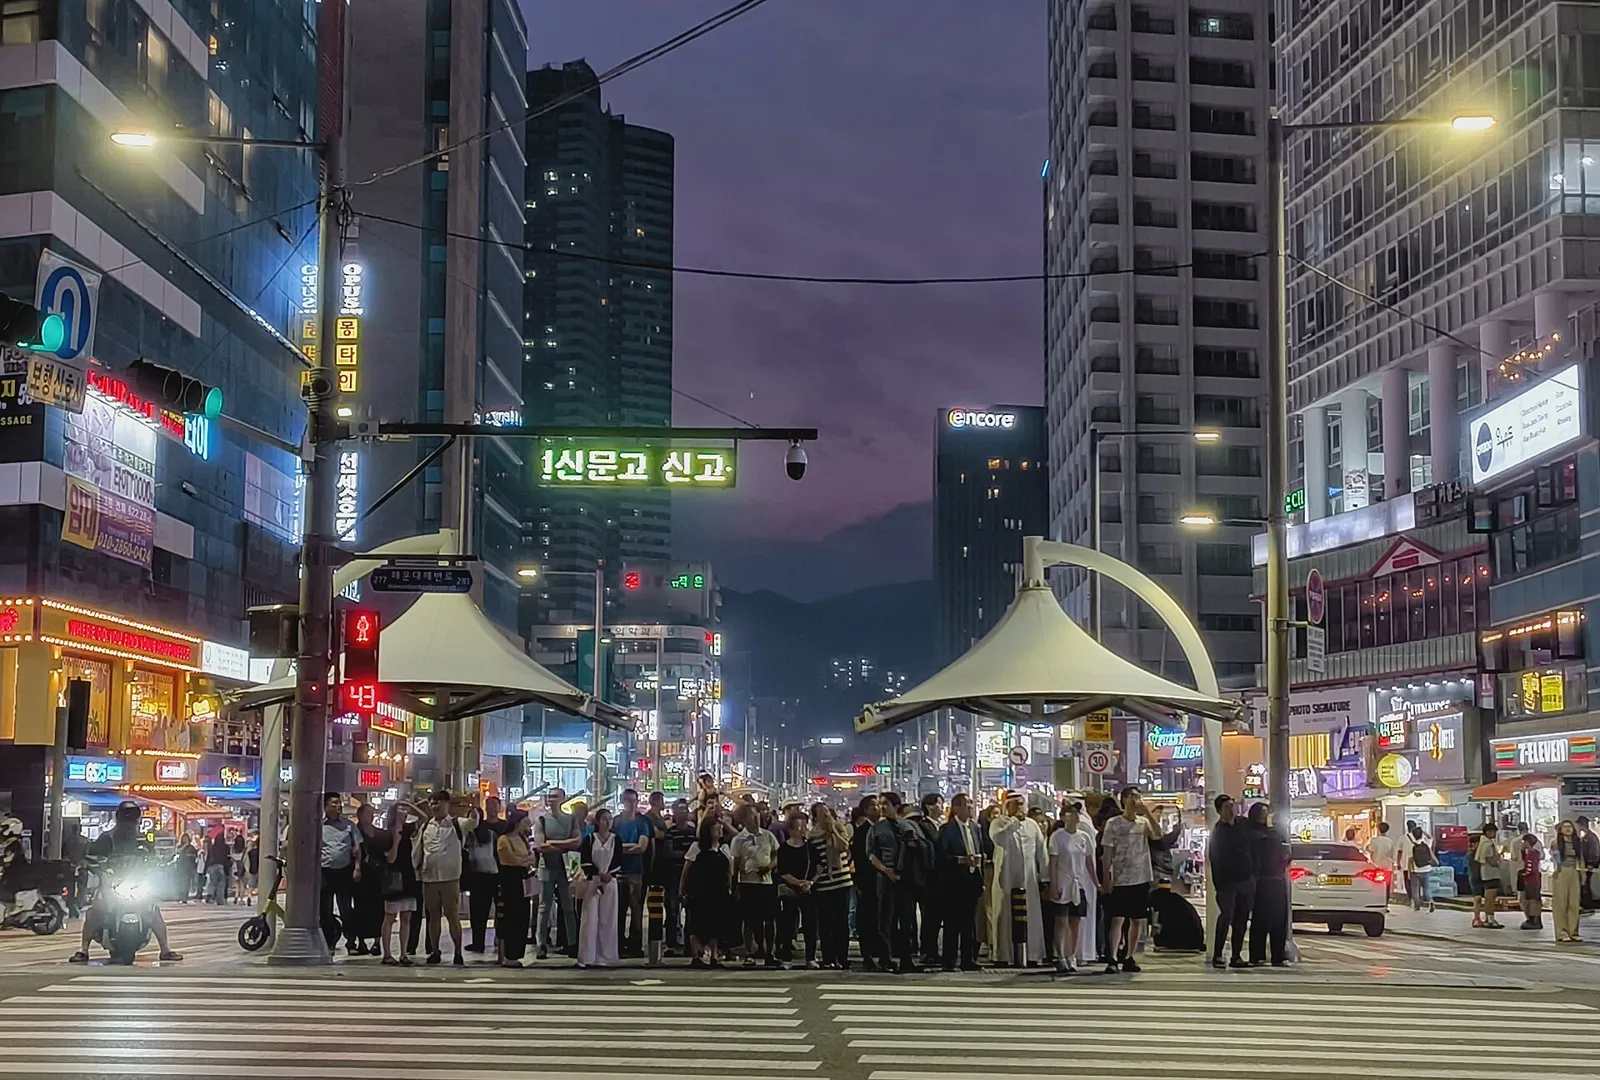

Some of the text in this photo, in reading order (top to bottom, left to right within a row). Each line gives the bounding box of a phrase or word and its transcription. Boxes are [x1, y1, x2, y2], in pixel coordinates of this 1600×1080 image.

[338, 320, 355, 390] 몽타이
[31, 361, 83, 403] 보행신호시
[68, 484, 97, 541] 임대
[391, 571, 453, 582] 해운대해변로
[350, 685, 375, 709] 43
[1289, 700, 1351, 715] PHOTO SIGNATURE
[1092, 756, 1104, 767] 30
